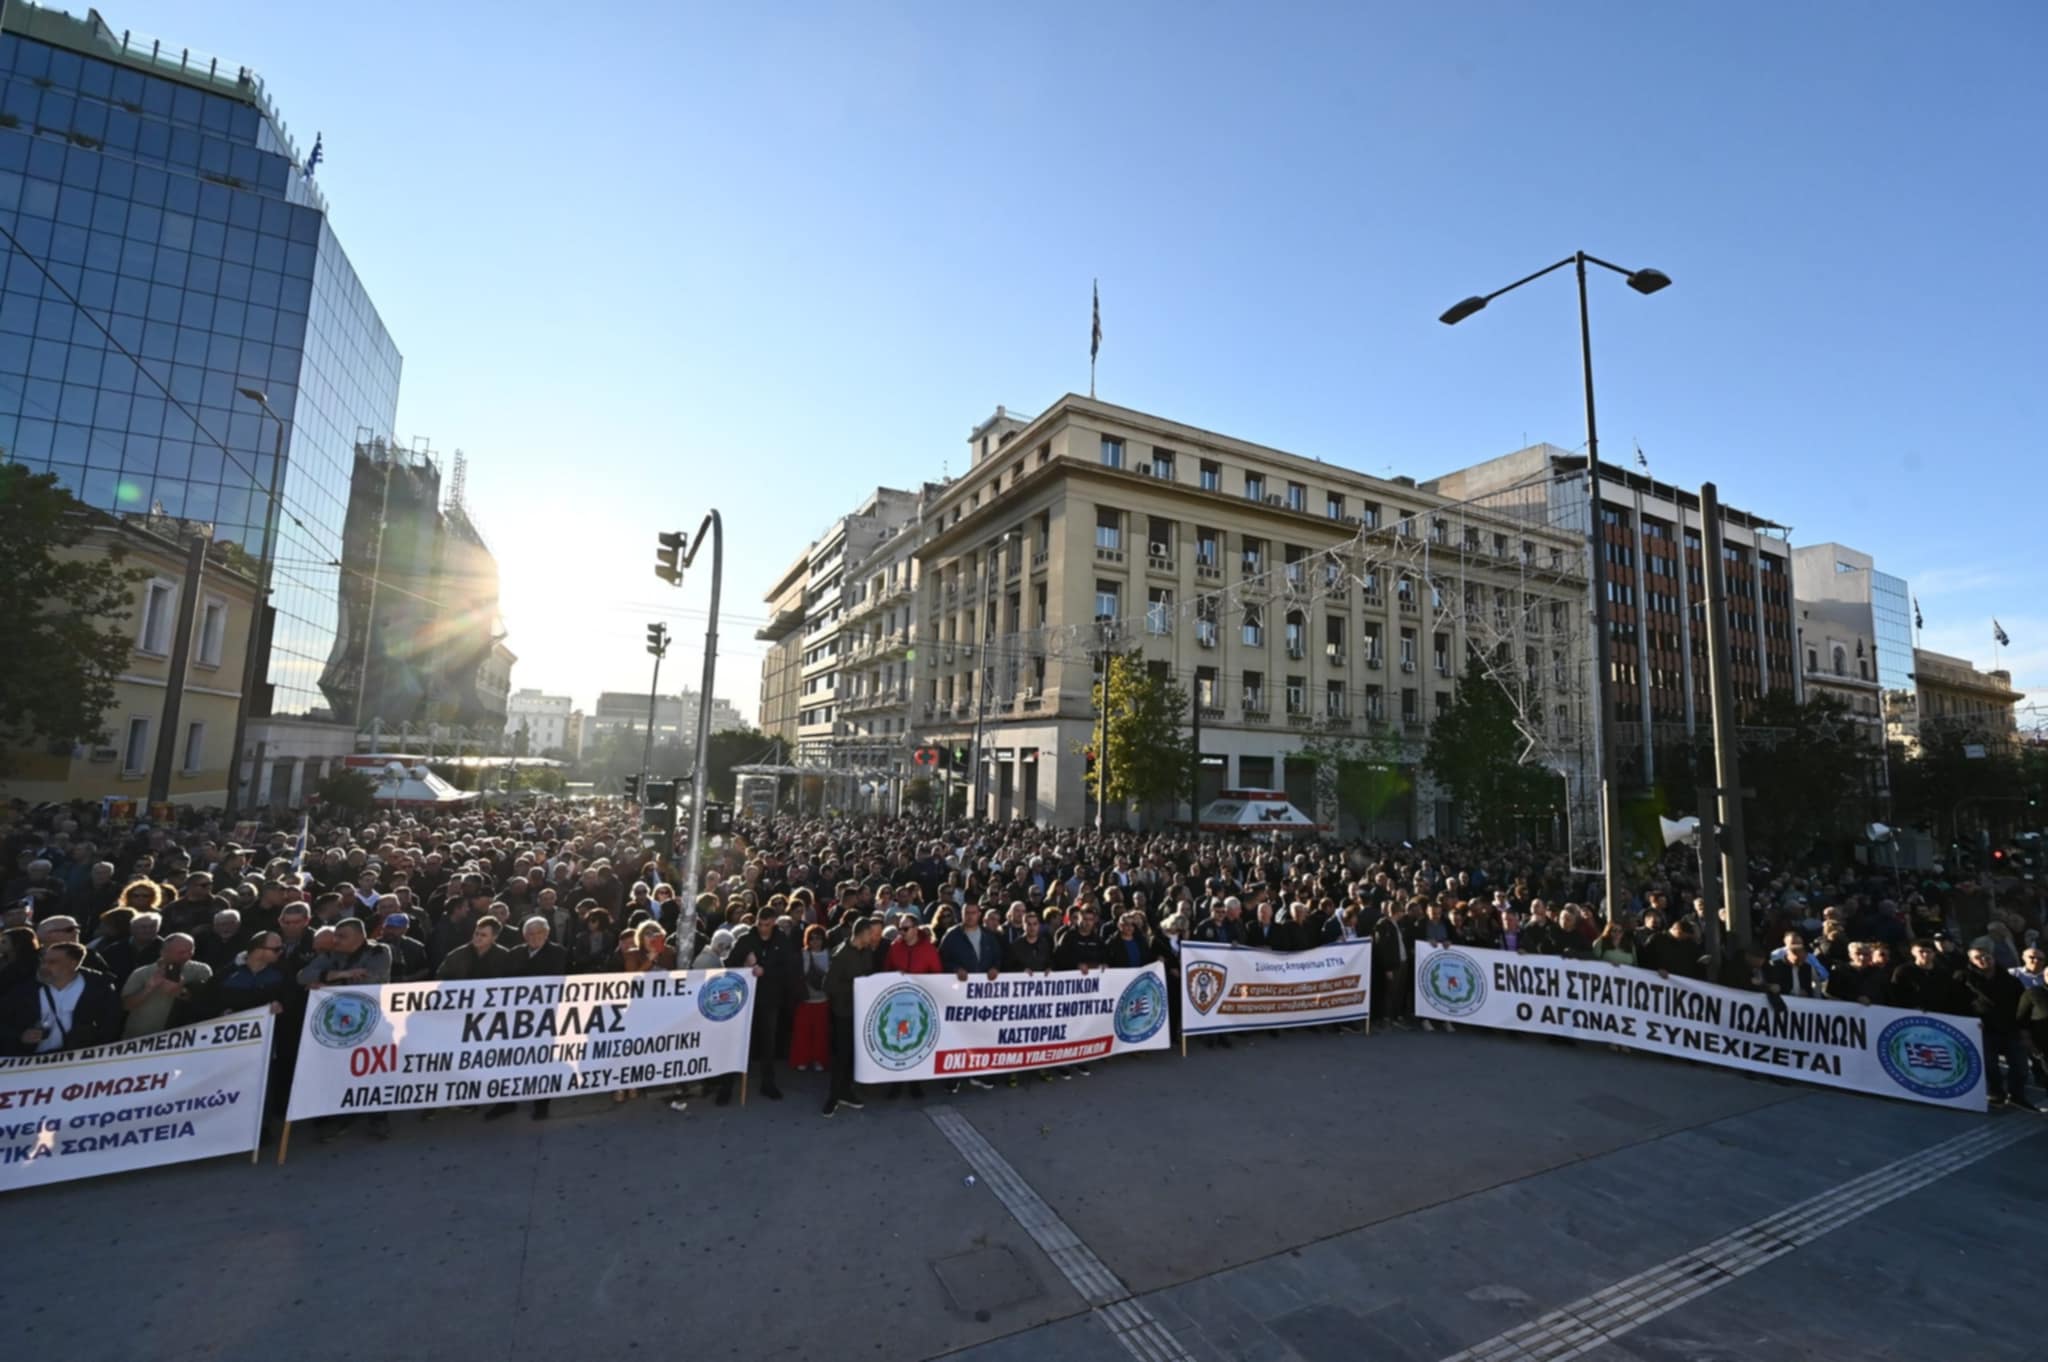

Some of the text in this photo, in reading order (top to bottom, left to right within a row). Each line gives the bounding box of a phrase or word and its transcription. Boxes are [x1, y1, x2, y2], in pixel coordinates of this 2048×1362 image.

[389, 989, 475, 1013] ΕΝΩΣΗ
[485, 984, 644, 1008] ΣΤΡΑΤΙΩΤΙΚΩΝ
[651, 978, 693, 998] Π.Ε.
[966, 977, 1099, 999] ΕΝΩΣΗ ΣΤΡΑΤΙΩΤΙΚΩΝ
[461, 1004, 627, 1042] ΚΑΒΑΛΑΣ
[945, 999, 1114, 1021] ΠΕΡΙΦΕΡΕΙΑΚΗΣ ΕΝΟΤΗΤΑΣ
[1493, 962, 1560, 998] ΕΝΩΣΗ
[1565, 970, 1722, 1026] ΣΤΡΑΤΙΩΤΙΚΩΝ
[1728, 1008, 1868, 1051] ΙΩΑΝΝΙΝΩΝ
[211, 1021, 262, 1043] ΣΟΕΔ
[998, 1025, 1067, 1044] ΚΑΣΤΟΡΙΑΣ
[1515, 1003, 1842, 1077] Ο ΑΓΩΝΑΣ ΣΥΝΕΧΙΖΕΤΑΙ
[349, 1031, 701, 1077] ΟΧΙ ΣΤΗΝ ΒΑΘΜΟΛΟΓΙΚΗ ΜΙΣΘΟΛΟΓΙΚΗ
[968, 1052, 990, 1067] ΣΤΟ
[992, 1050, 1023, 1066] ΣΩΜΑ
[1025, 1042, 1107, 1063] ΥΠΑΞΙΩΜΑΤΙΚΩΝ
[61, 1072, 170, 1101] ΦΙΜΩΣΗ
[340, 1056, 712, 1108] ΑΠΑΞΙΩΣΗ ΤΩΝ ΘΕΣΜΩΝ ΑΣΣΥ-ΕΜΘ-ΕΠ.ΟΠ.
[69, 1089, 241, 1129] στρατιωτικών
[60, 1121, 196, 1156] ΣΩΜΑΤΕΙΑ
